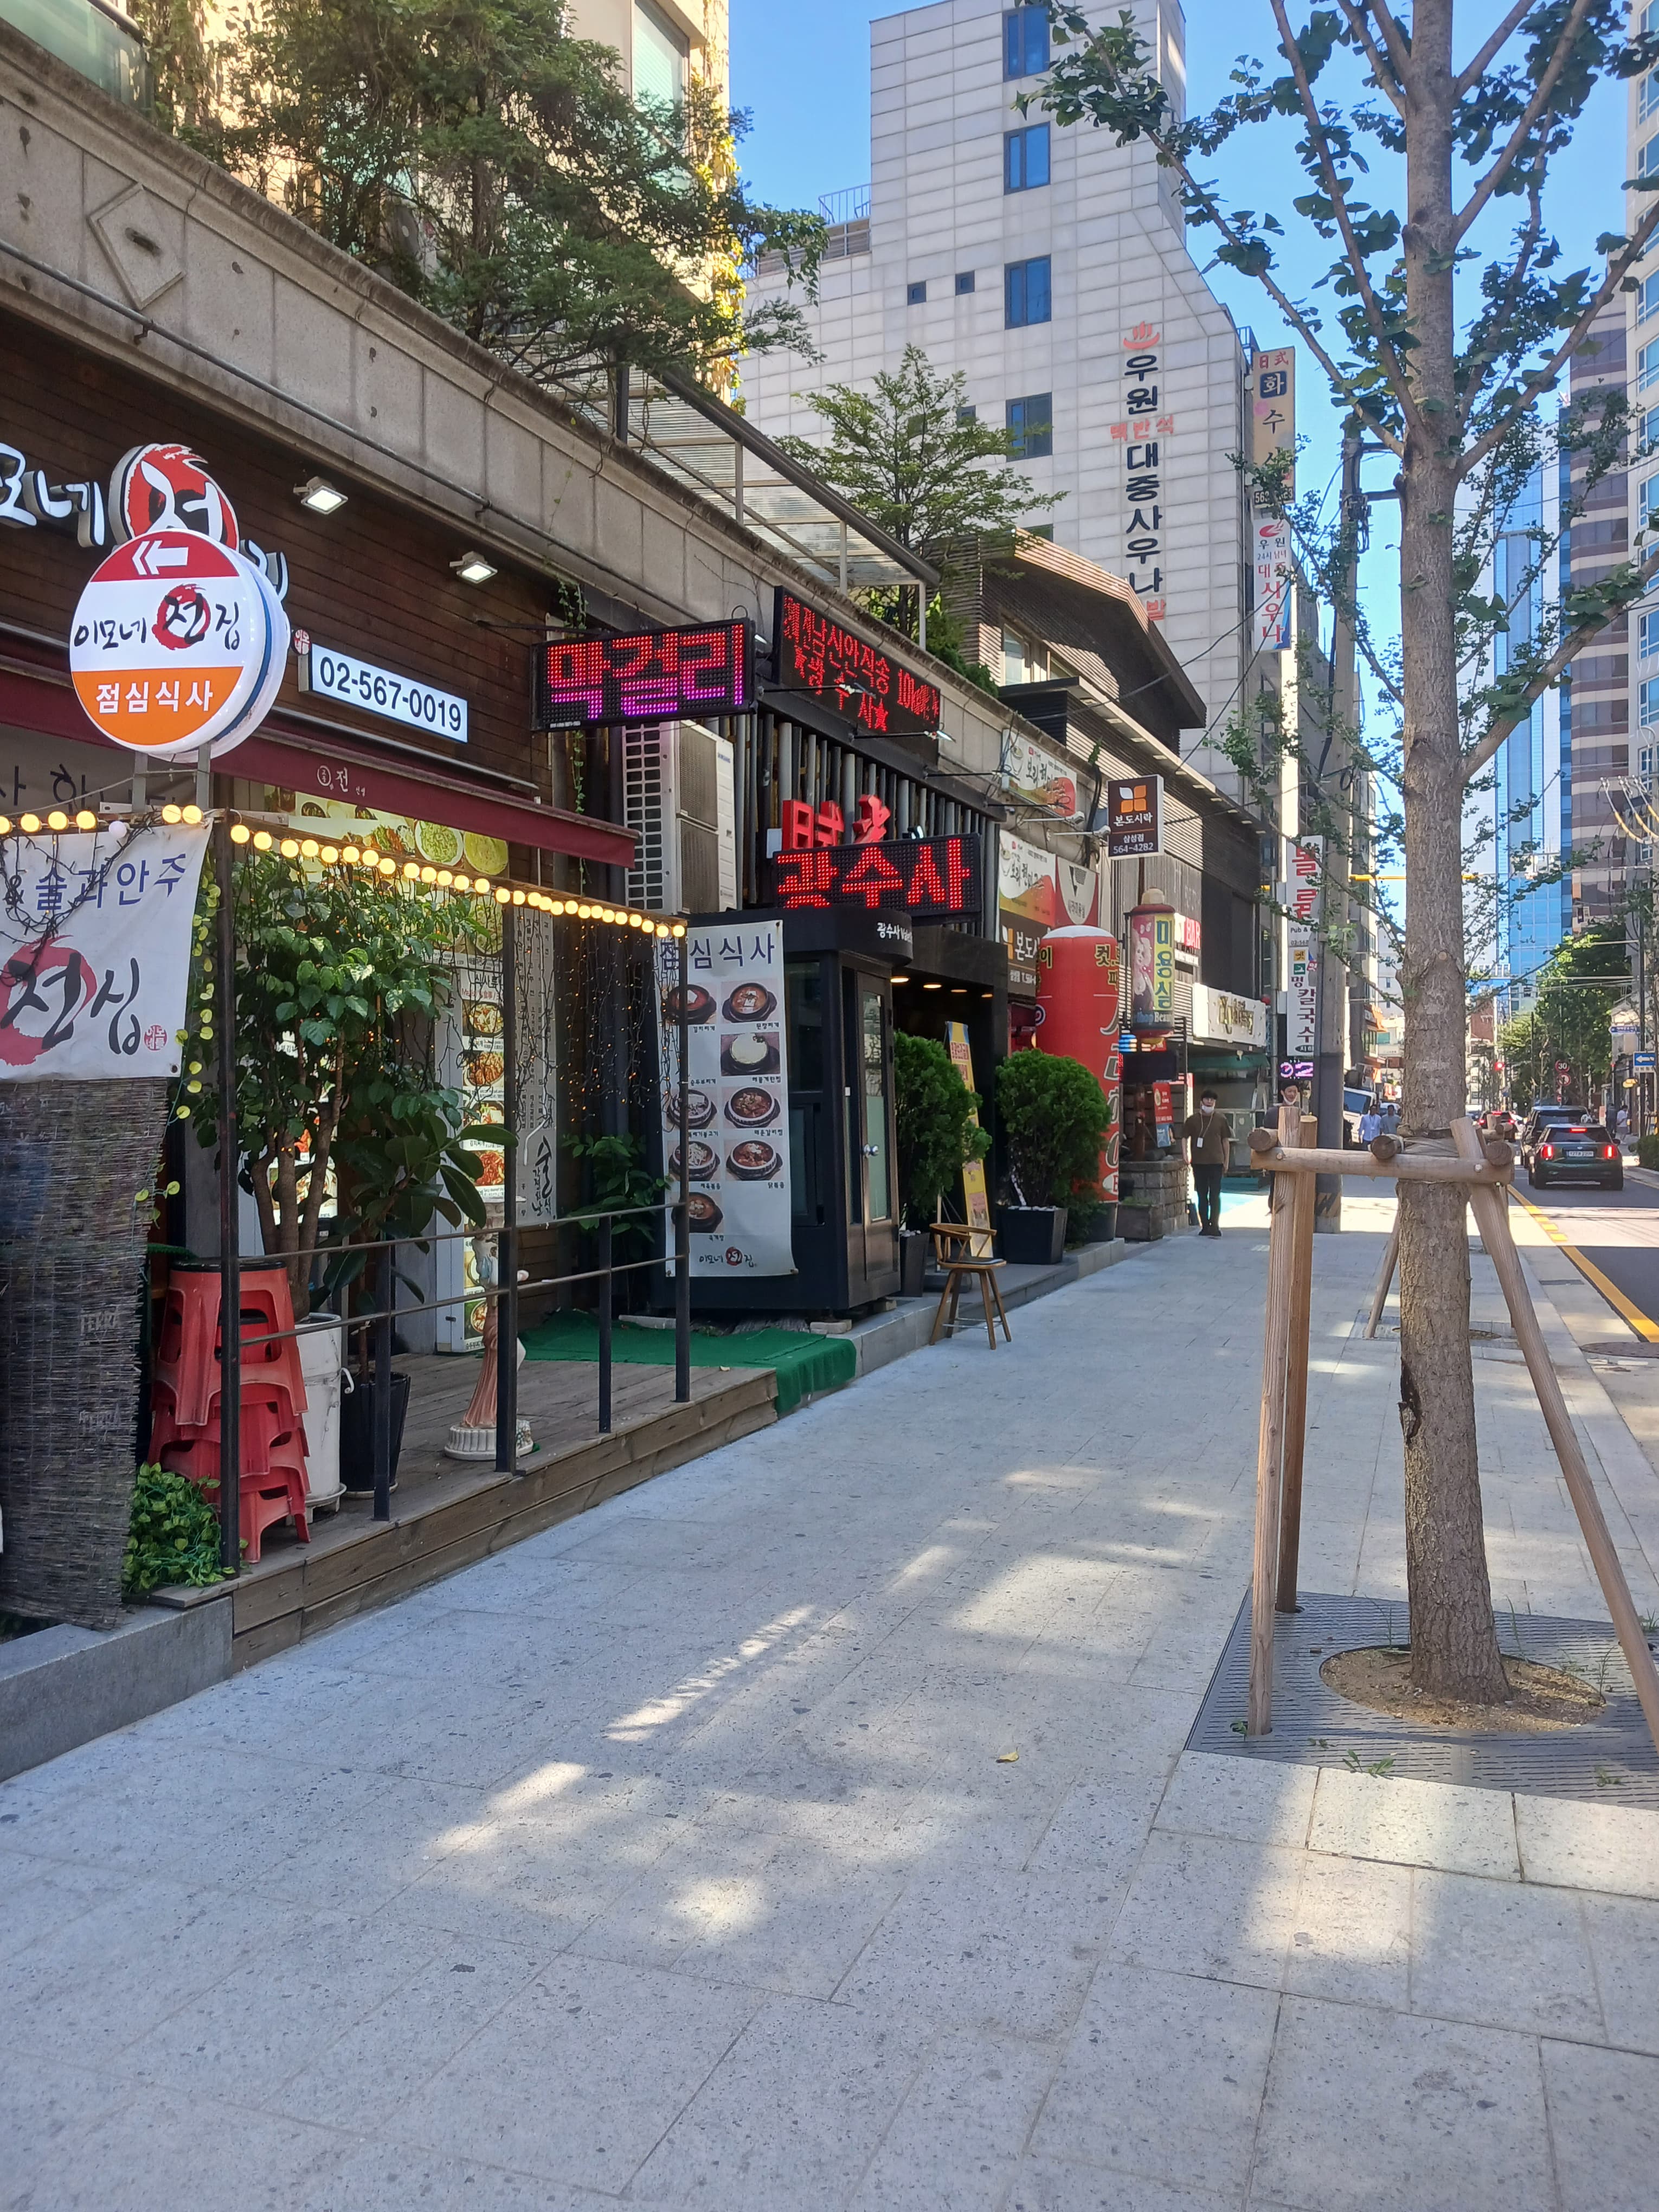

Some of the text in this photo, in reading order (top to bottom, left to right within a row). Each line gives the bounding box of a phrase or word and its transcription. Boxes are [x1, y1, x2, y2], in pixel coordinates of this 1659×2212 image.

[1258, 537, 1285, 550] 우원
[74, 616, 147, 650] 이모네
[547, 623, 744, 720] 막걸리
[96, 680, 213, 715] 점심식사
[320, 656, 461, 731] 02-567-0019
[1113, 813, 1153, 826] 본도시락
[1113, 843, 1154, 854] 564-4282
[1123, 834, 1144, 844] 삼성점
[777, 838, 970, 910] 광수사
[1155, 919, 1173, 1009] 미용실
[1297, 988, 1316, 1043] 칼국수
[698, 1253, 724, 1265] 이모네
